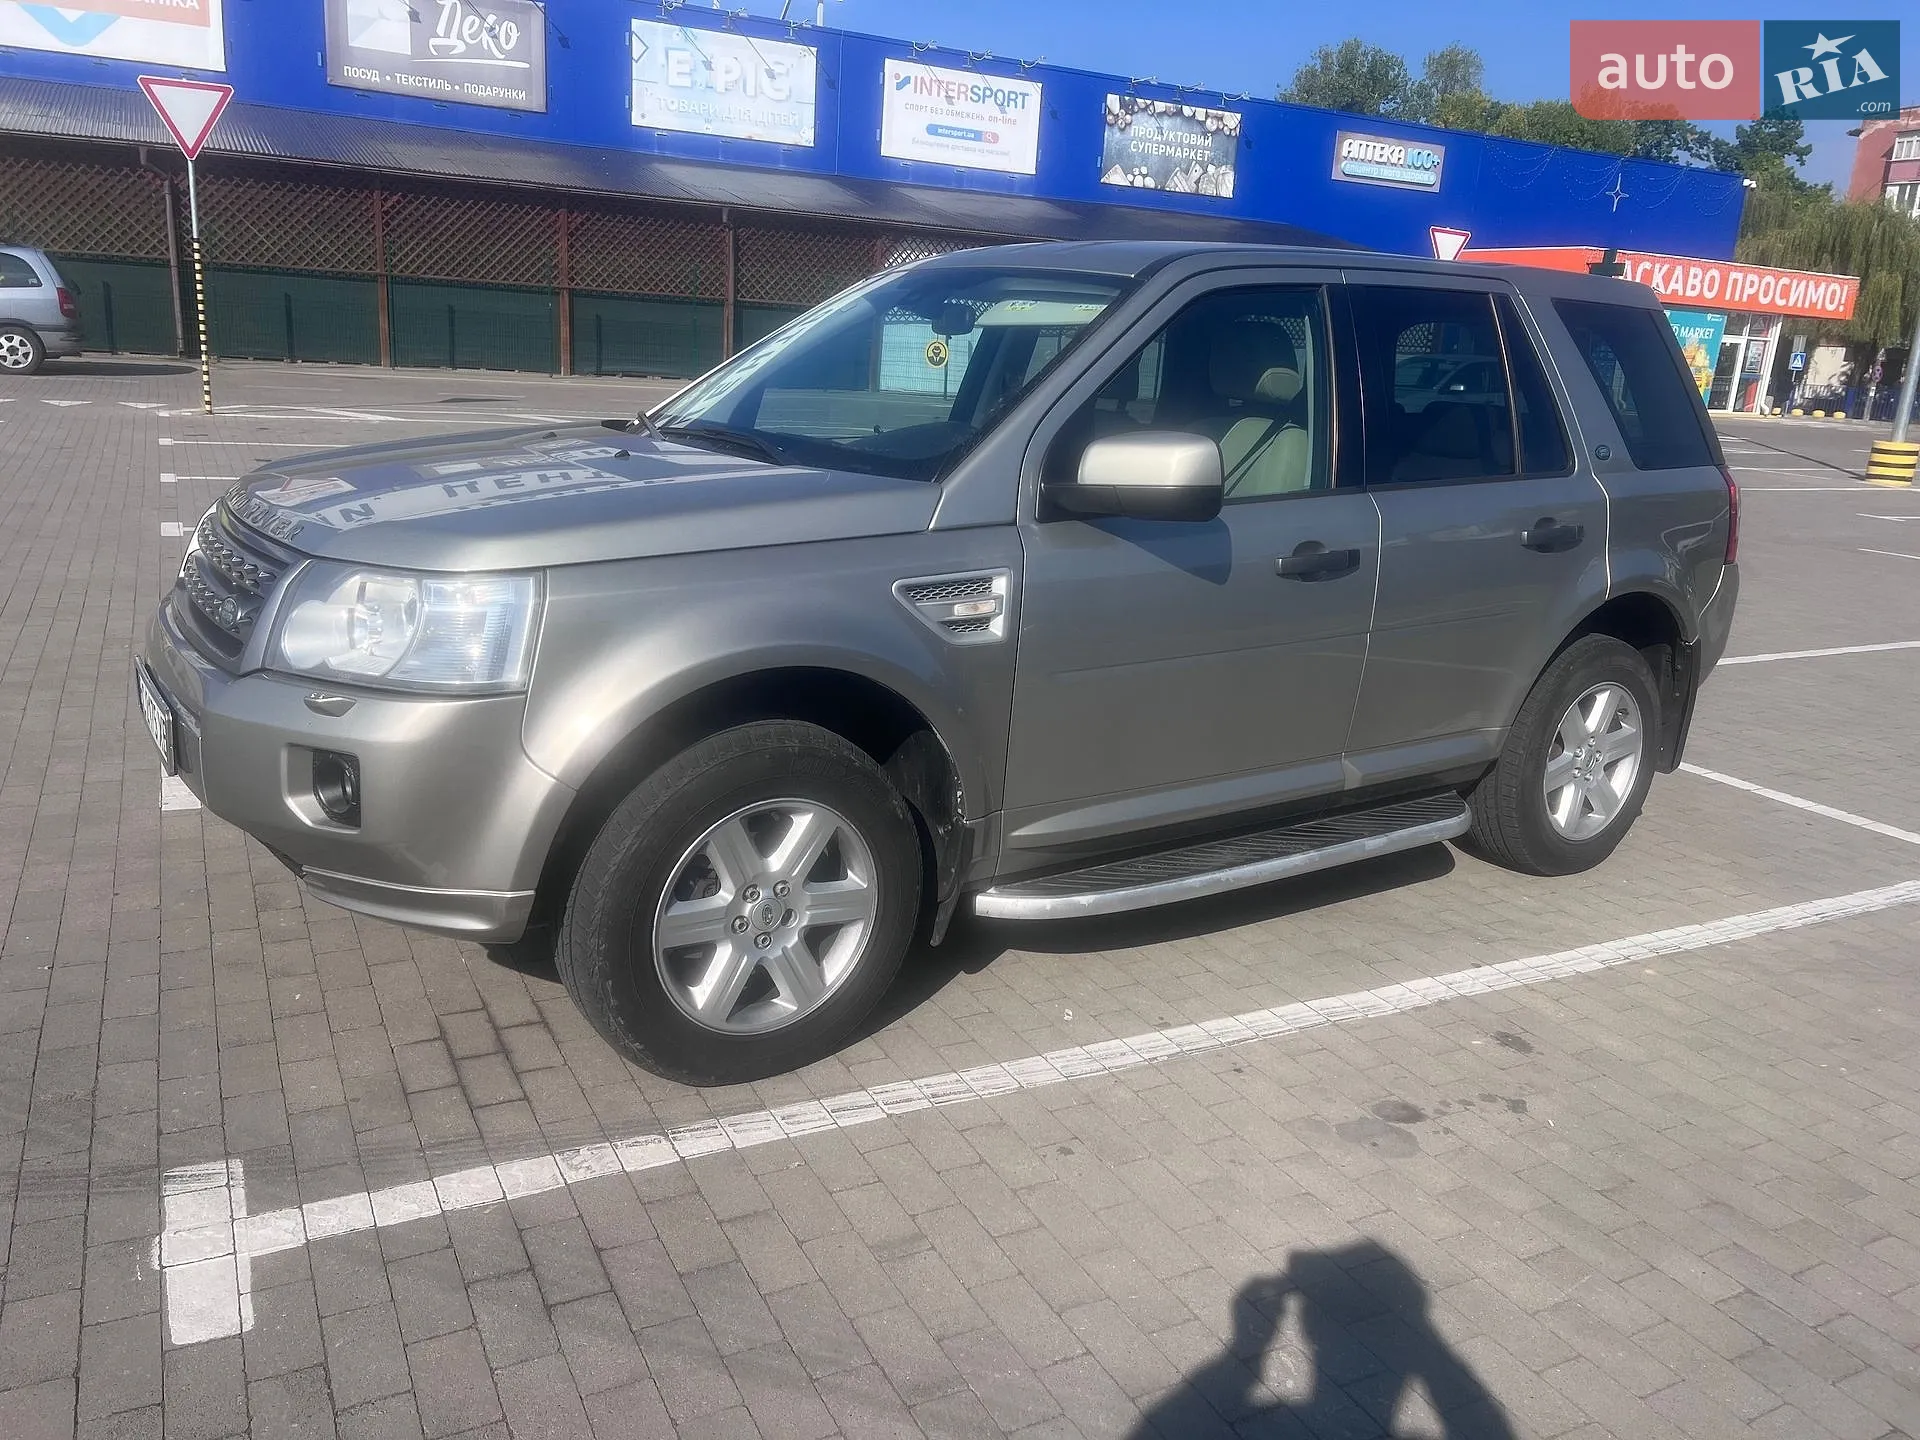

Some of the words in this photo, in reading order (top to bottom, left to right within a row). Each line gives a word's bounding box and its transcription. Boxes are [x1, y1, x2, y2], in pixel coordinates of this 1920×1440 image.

[429, 0, 520, 59] Деко
[343, 65, 380, 83] ПОСУД
[394, 72, 451, 91] ТЕКСТИЛЬ
[464, 82, 526, 101] ПОДАРУНКИ
[913, 75, 1029, 110] INTERSPORT
[656, 97, 720, 116] ТОВАРИ
[904, 102, 928, 113] СПОРТ
[930, 106, 944, 115] БЕЗ
[945, 108, 985, 121] ОБМЕЖЕНЬ
[1131, 126, 1213, 147] ПРОДУКТОВИЙ
[1130, 140, 1211, 161] СУПЕРМАРКЕТ
[1342, 138, 1405, 165] АПТЕКА
[1725, 271, 1848, 313] ПРОСИМО!
[1680, 326, 1715, 339] MARKET
